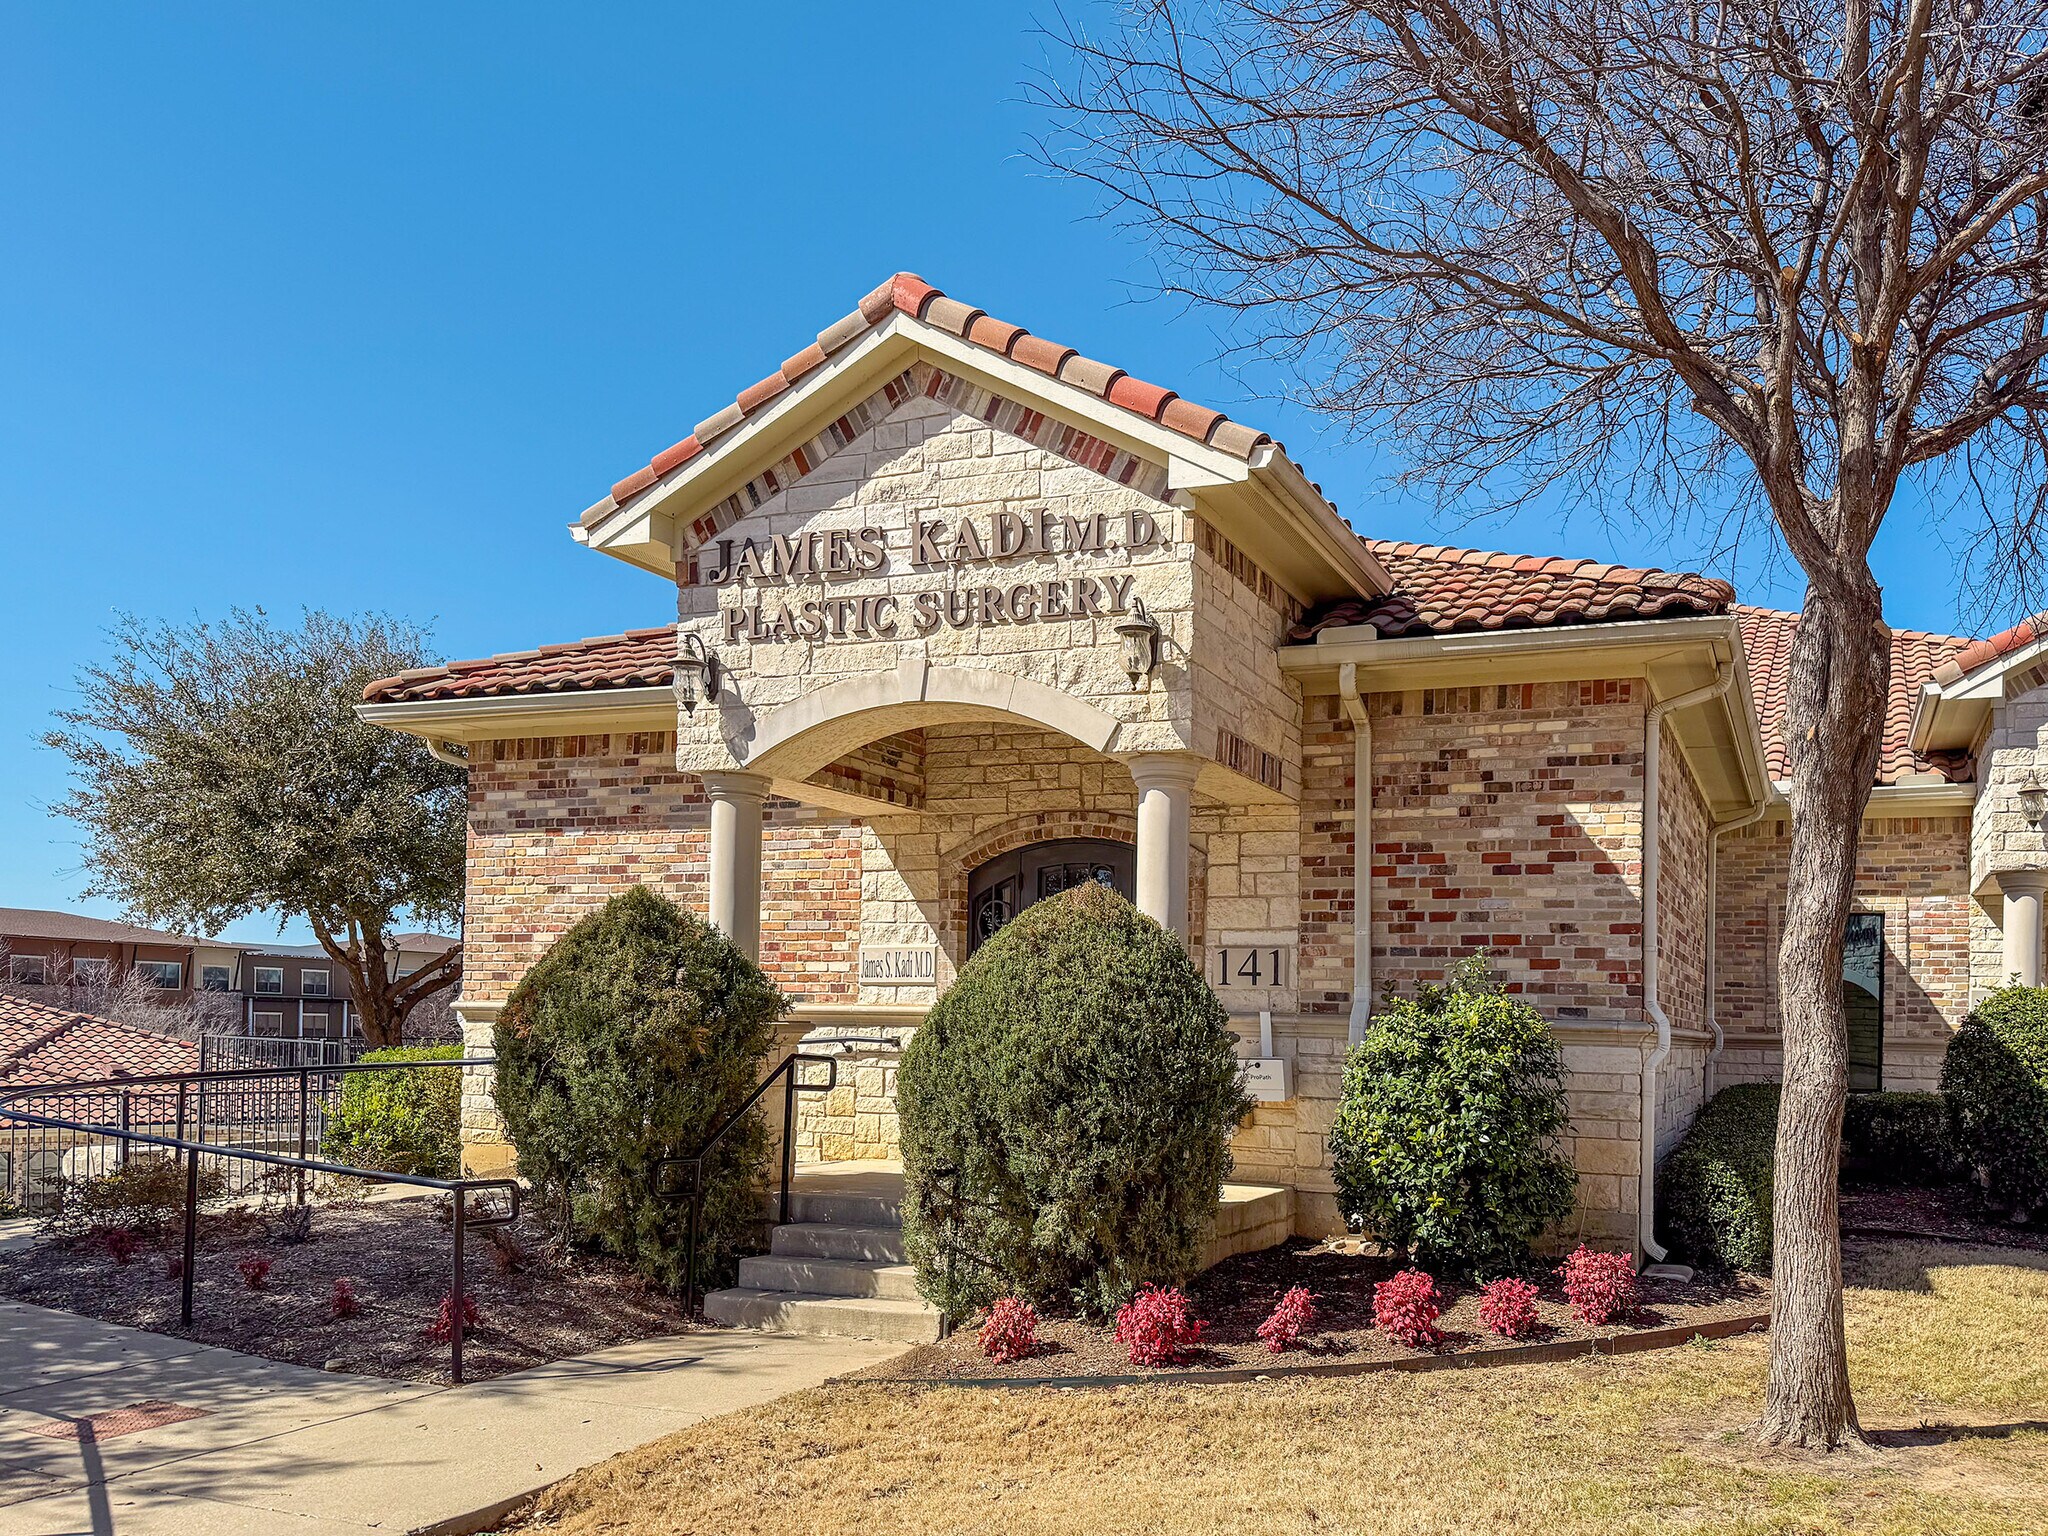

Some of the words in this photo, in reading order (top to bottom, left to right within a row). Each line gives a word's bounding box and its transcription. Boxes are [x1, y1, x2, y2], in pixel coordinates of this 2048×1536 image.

[709, 525, 885, 585] JAMES
[910, 507, 1050, 566] KADI
[1060, 509, 1166, 551] M.D.
[722, 596, 896, 642] PLASTIC
[913, 575, 1137, 628] SURGERY
[861, 952, 884, 979] James
[885, 951, 893, 978] S.
[895, 951, 913, 978] Kadi
[914, 951, 934, 978] M.D.
[1217, 948, 1283, 987] 141
